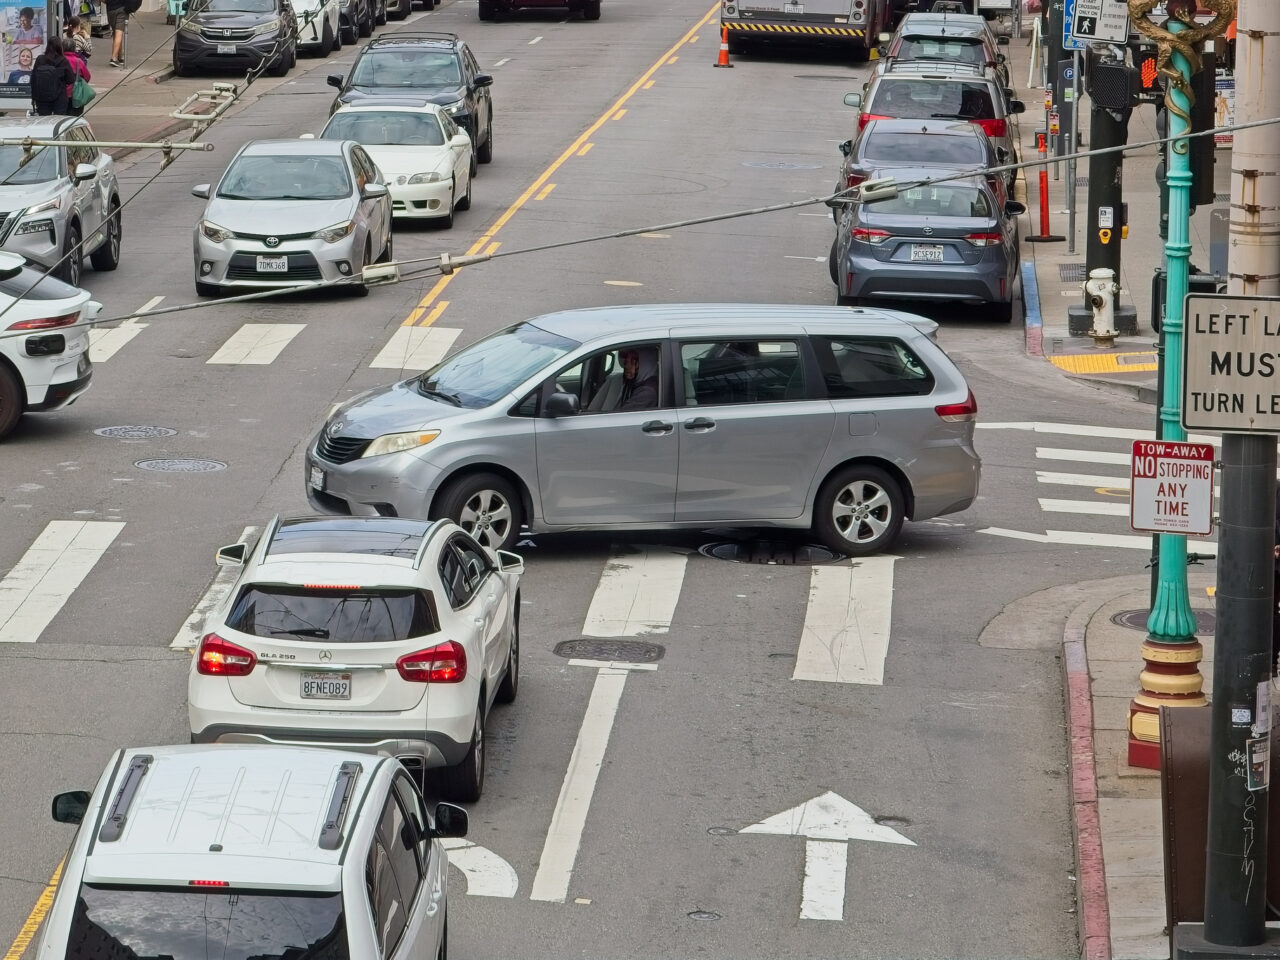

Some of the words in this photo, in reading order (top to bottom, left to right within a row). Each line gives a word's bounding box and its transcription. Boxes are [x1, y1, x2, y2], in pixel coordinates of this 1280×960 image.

[1195, 313, 1250, 336] LEFT
[1191, 392, 1245, 414] TURN
[1256, 394, 1280, 414] LE
[1140, 443, 1207, 458] TOW-AWAY
[1134, 455, 1156, 477] NO
[1159, 461, 1210, 480] STOPPING
[1157, 482, 1188, 499] ANY
[1154, 500, 1190, 517] TIME
[303, 681, 348, 695] 8FNE089
